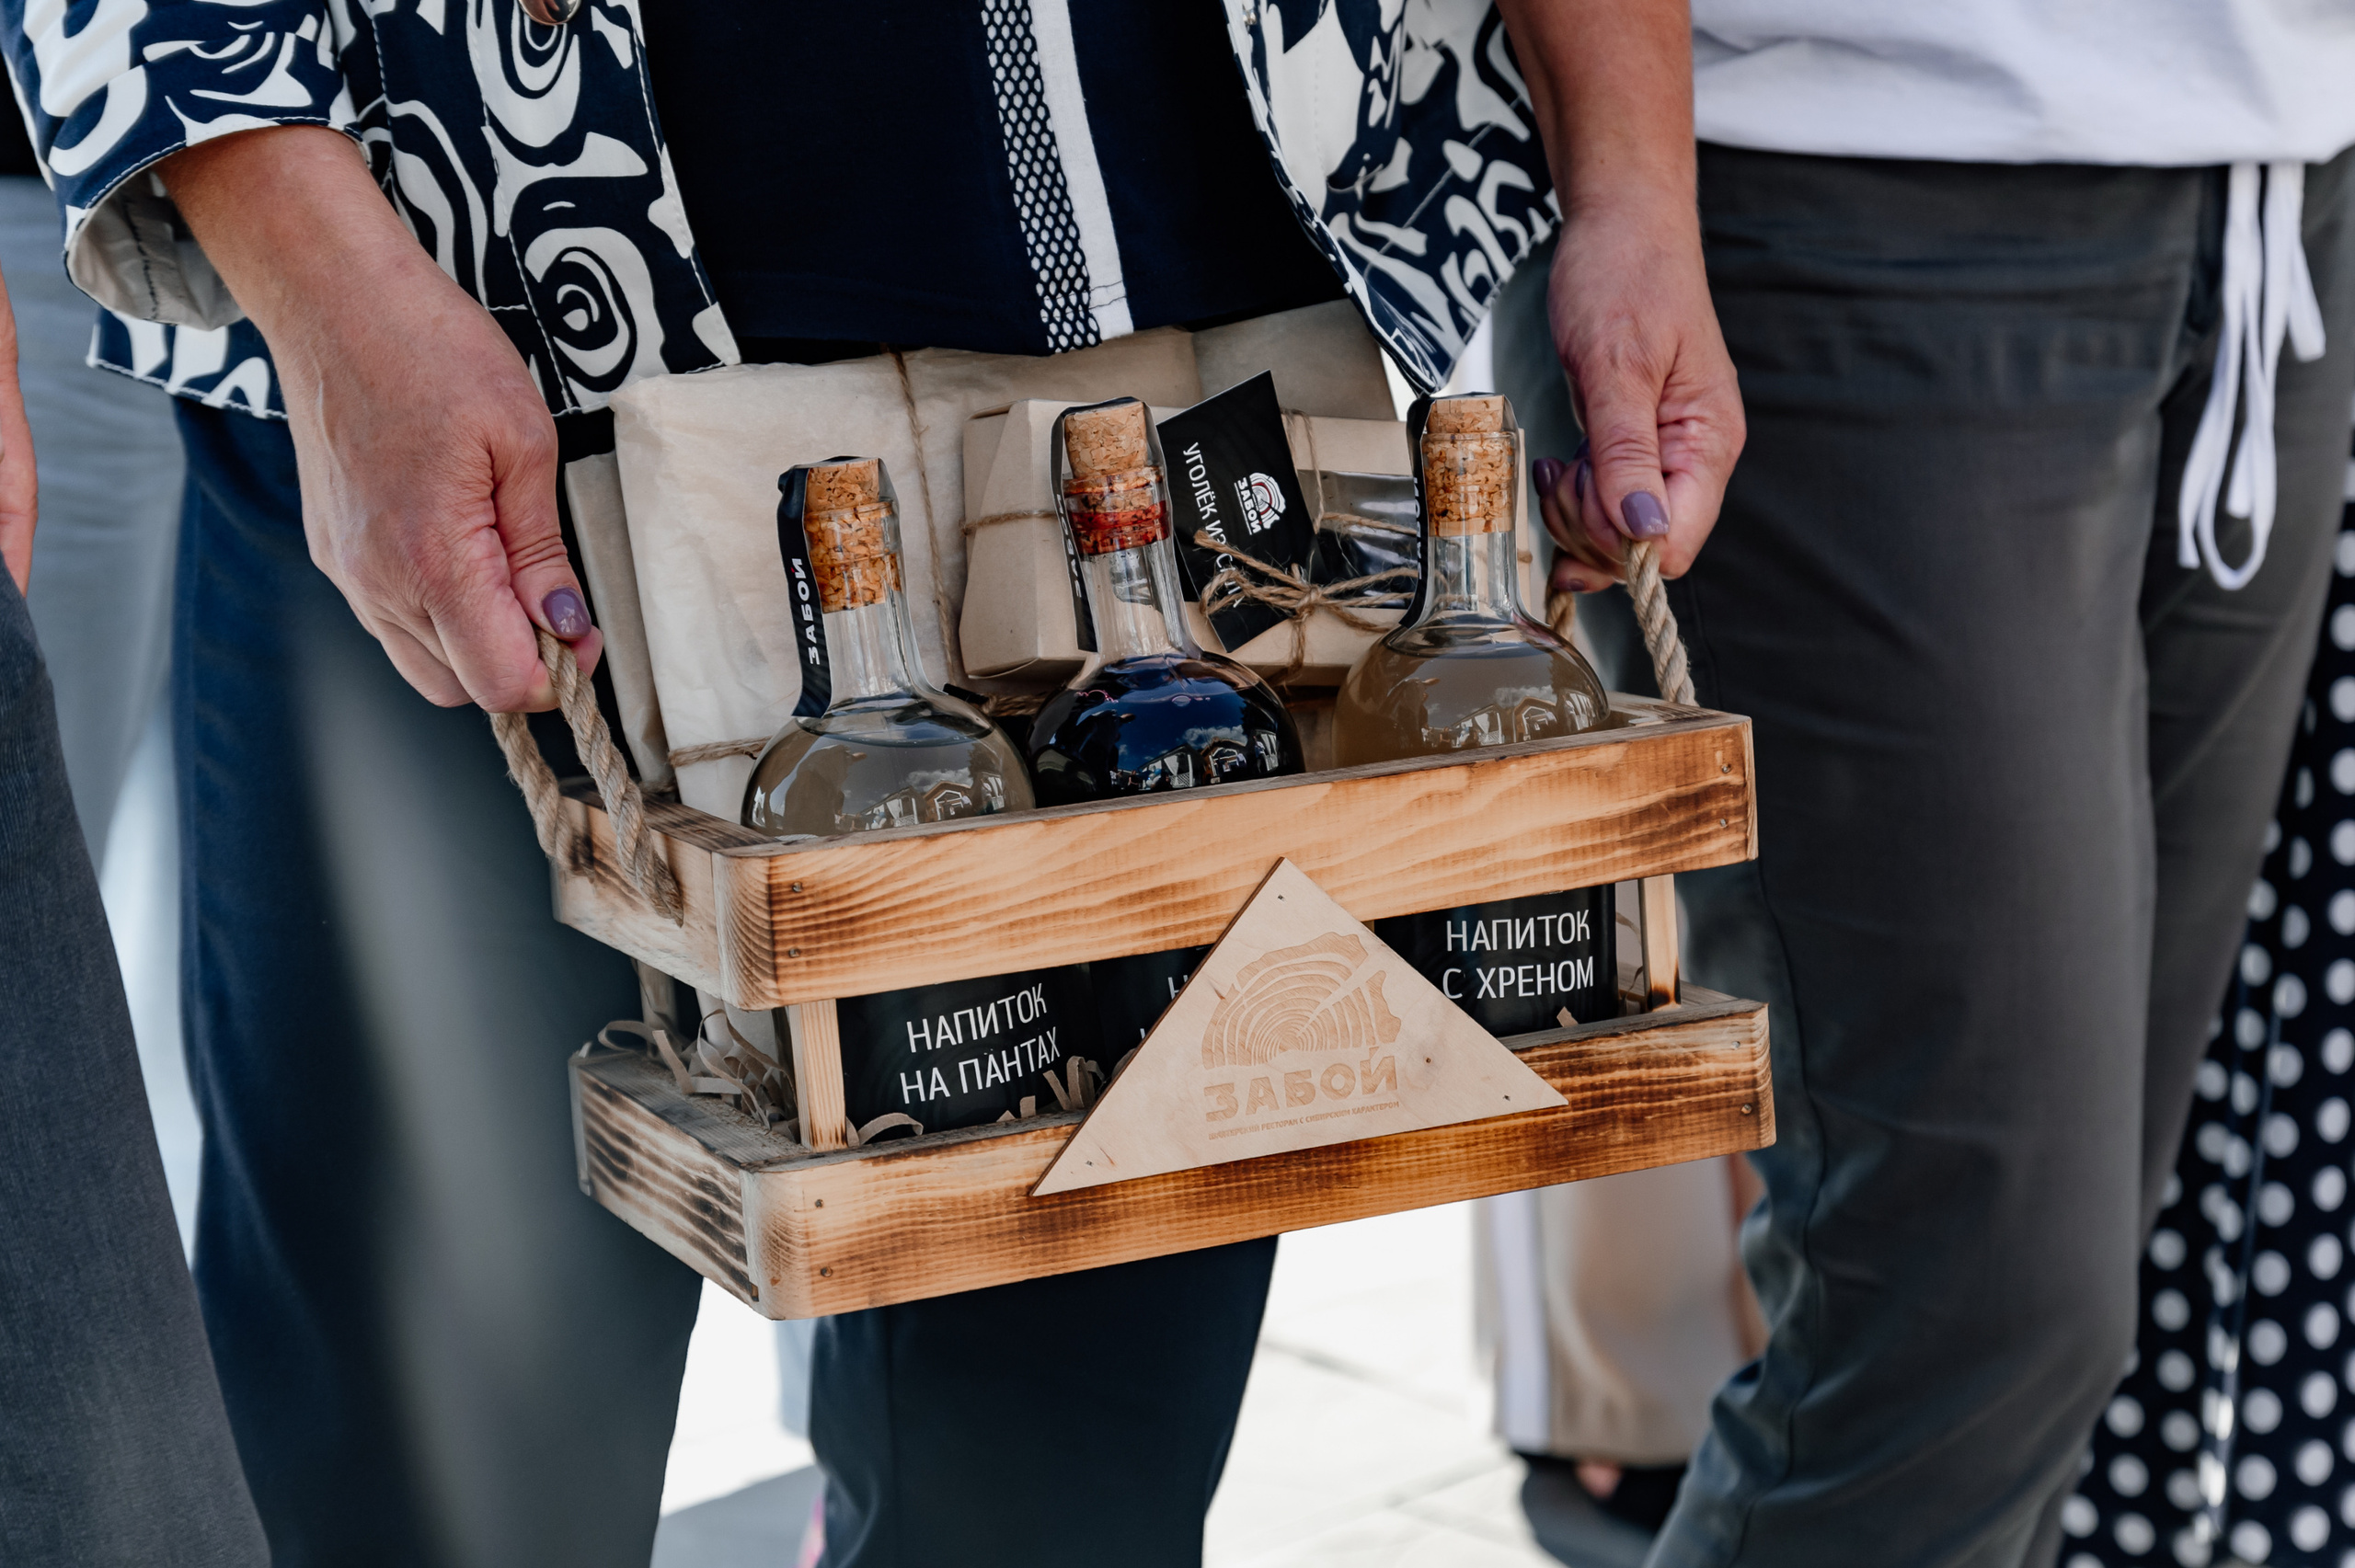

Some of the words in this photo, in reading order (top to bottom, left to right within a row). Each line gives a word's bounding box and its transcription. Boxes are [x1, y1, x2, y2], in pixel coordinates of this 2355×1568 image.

[1183, 441, 1218, 521] УГОЛЁК
[1237, 476, 1262, 533] ЗАБОЙ
[791, 557, 821, 666] ЗАБОЙ
[1446, 909, 1591, 952] НАПИТОК
[1442, 967, 1464, 1000] С
[1476, 956, 1594, 1000] ХРЕНОМ
[906, 982, 1047, 1053] НАПИТОК
[900, 1066, 951, 1104] НА
[959, 1025, 1061, 1094] ПАНТАХ
[1203, 1046, 1398, 1123] ЗАБОЙ
